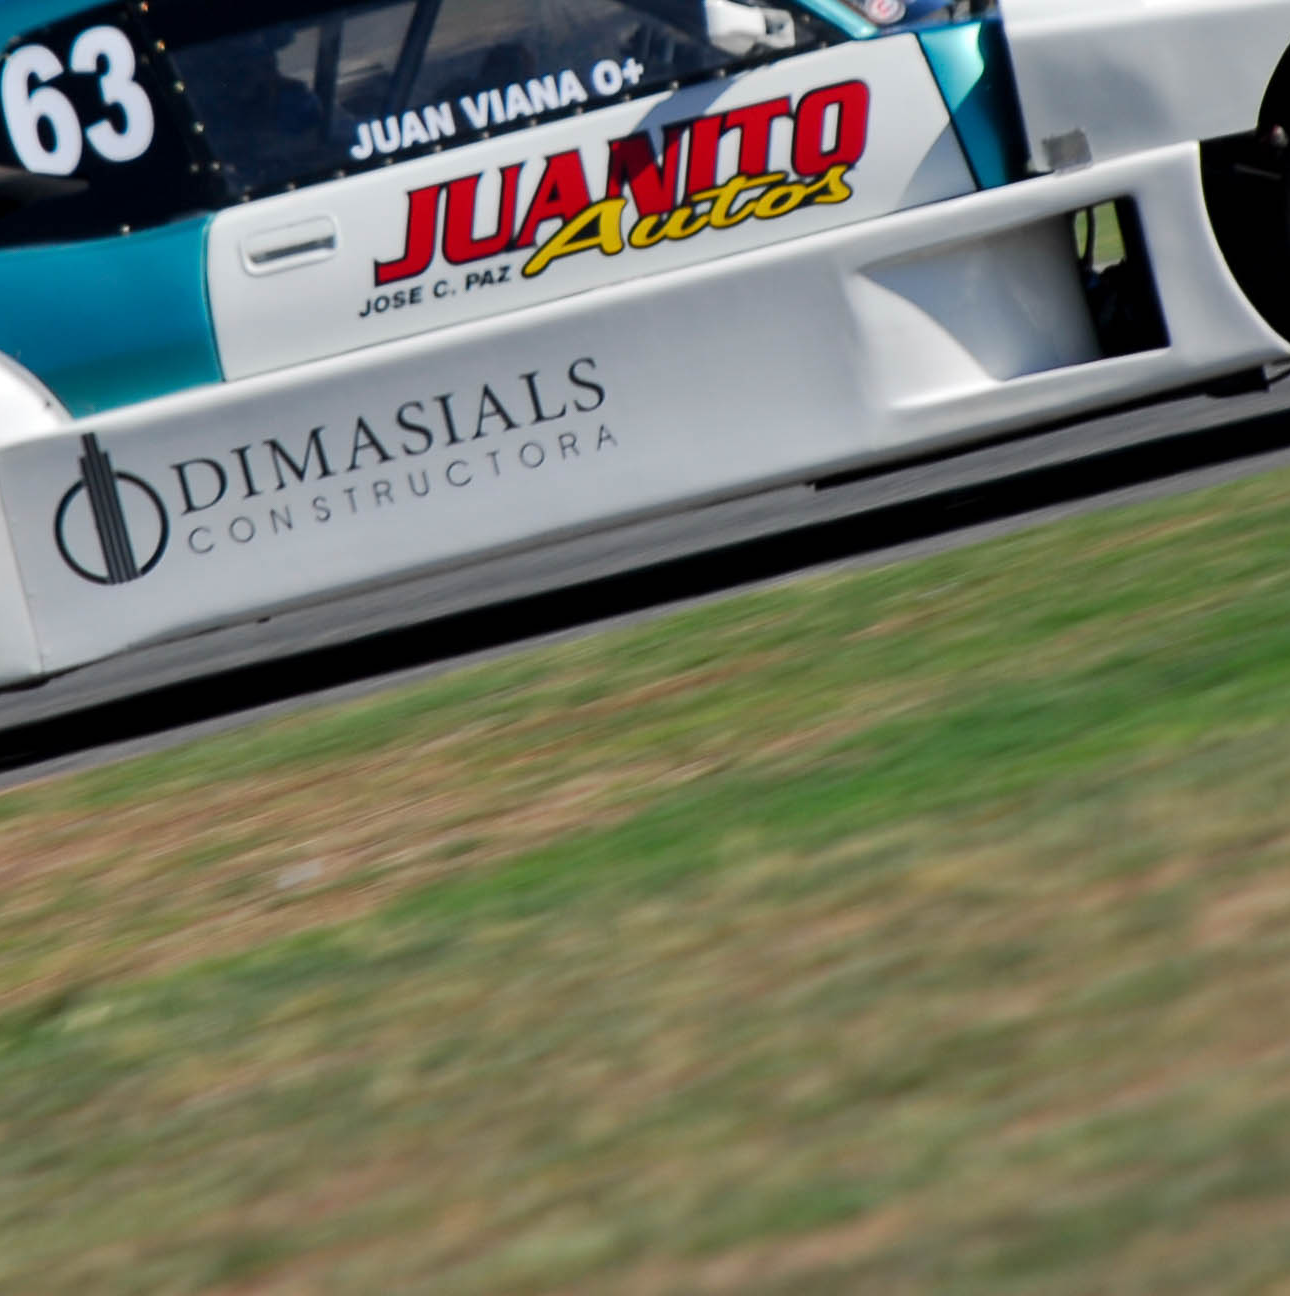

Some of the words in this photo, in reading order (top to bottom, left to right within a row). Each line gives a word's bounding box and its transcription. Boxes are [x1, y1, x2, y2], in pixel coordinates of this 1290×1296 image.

[0, 24, 155, 178] 63
[349, 115, 457, 162] JUAN
[459, 68, 588, 130] VIANA
[373, 78, 871, 288] JUANITO
[520, 163, 854, 278] Autos
[358, 284, 424, 319] JOSE
[432, 278, 457, 302] C.
[464, 264, 512, 295] PAZ
[170, 355, 608, 518] DIMASIALS
[187, 422, 619, 555] CONSTRUCTORA
